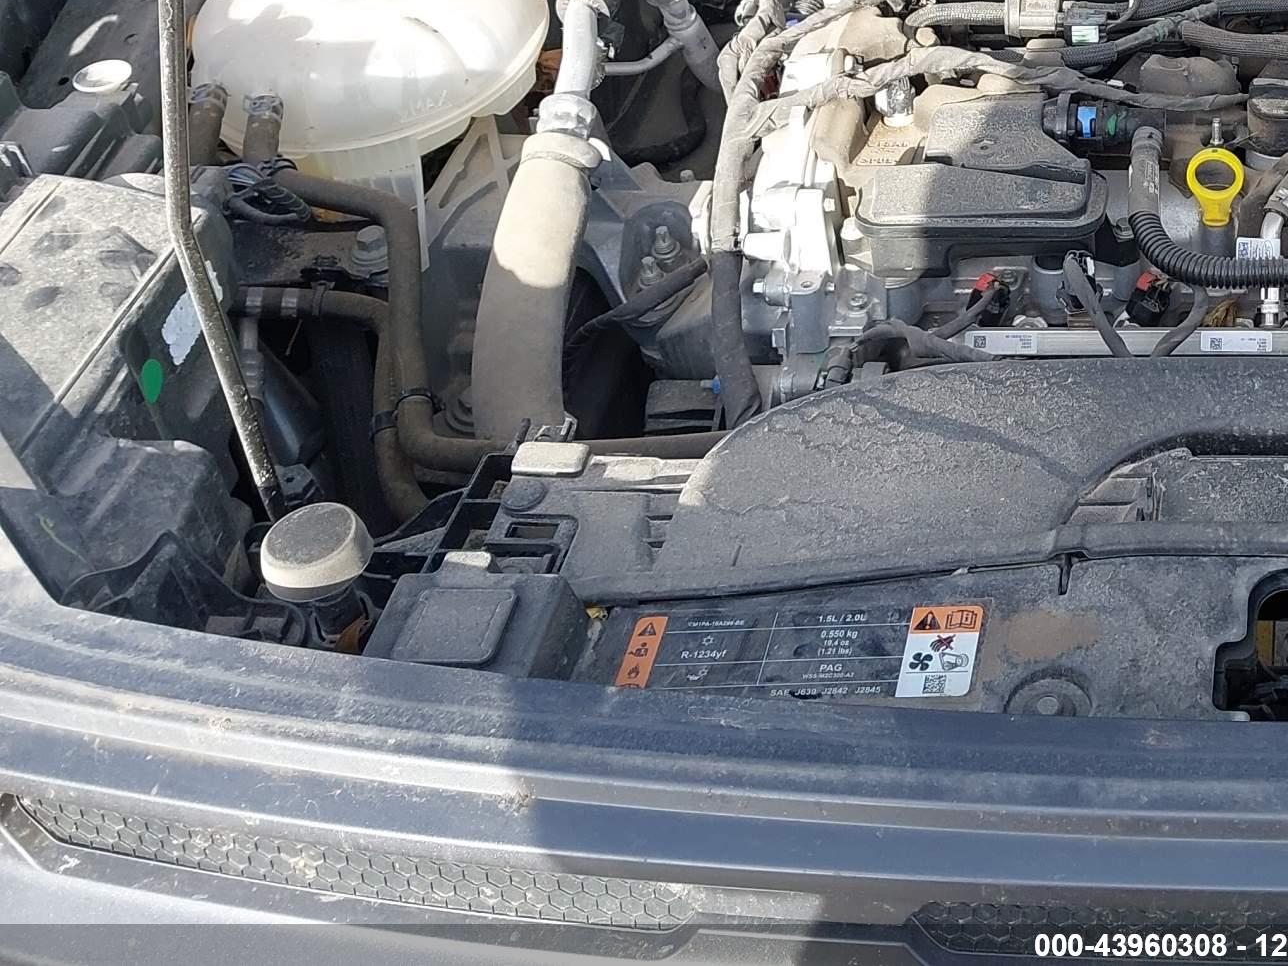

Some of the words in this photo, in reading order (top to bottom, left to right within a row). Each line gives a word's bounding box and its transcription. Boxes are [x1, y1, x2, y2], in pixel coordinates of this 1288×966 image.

[819, 614, 838, 623] 1.5L
[845, 613, 868, 622] 2.0L
[820, 629, 845, 639] 0.550
[846, 629, 858, 639] kg
[680, 650, 728, 660] R-1234yf
[819, 663, 843, 672] PAG
